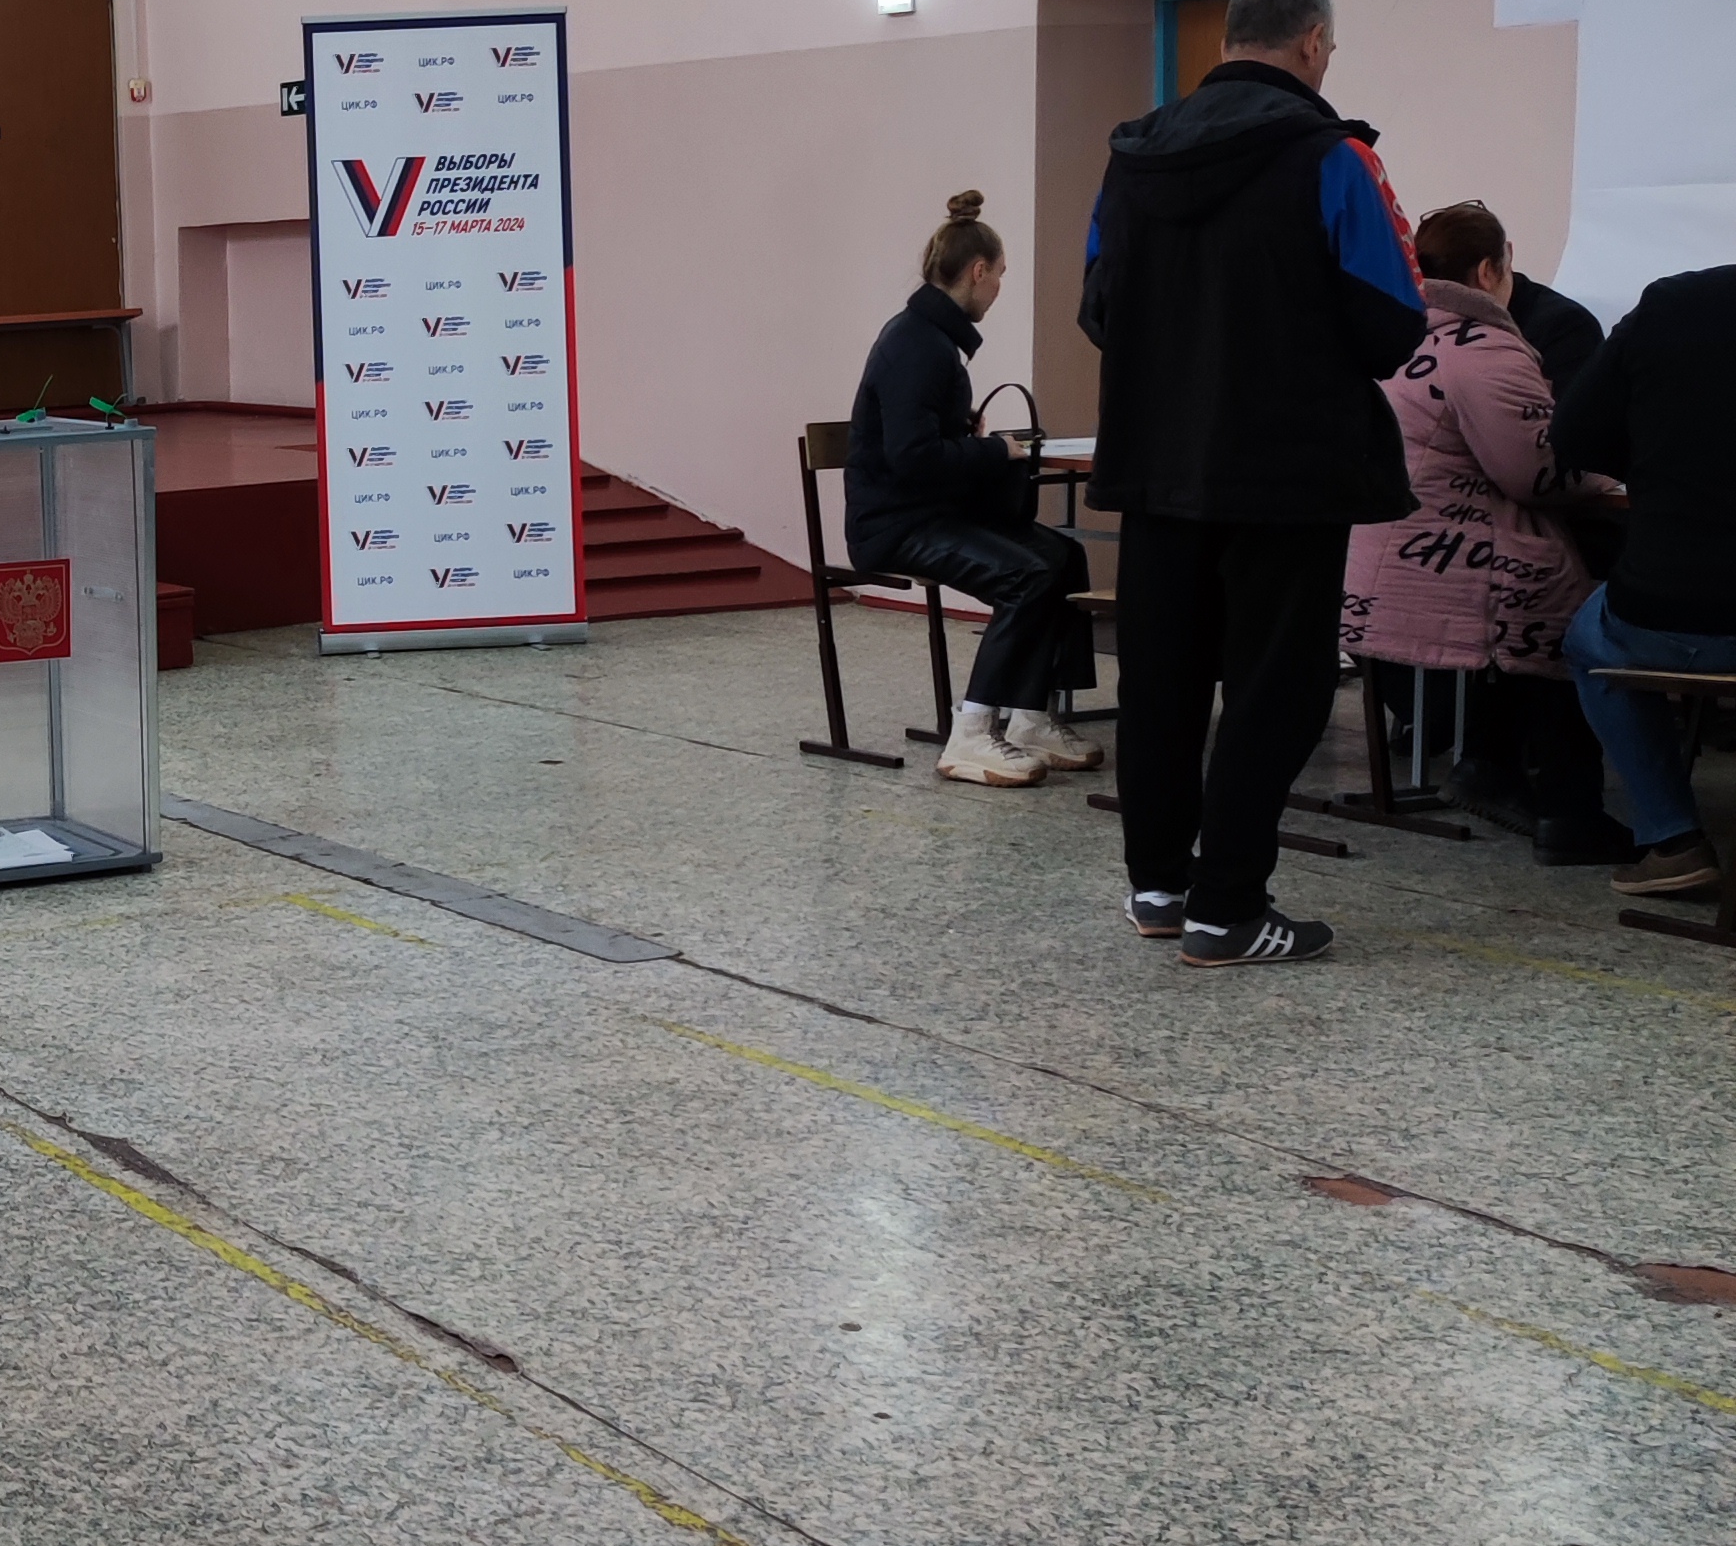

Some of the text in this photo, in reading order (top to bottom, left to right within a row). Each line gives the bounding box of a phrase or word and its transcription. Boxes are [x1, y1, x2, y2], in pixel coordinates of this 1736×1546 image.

[418, 57, 455, 68] ЦИК.РФ
[497, 93, 534, 104] ЦИК.РФ
[341, 100, 378, 111] ЦИК.РФ
[434, 153, 516, 172] ВЫБОРЫ
[426, 173, 540, 194] ПРЕЗИДЕНТА
[417, 197, 491, 216] РОССИИ
[447, 218, 492, 234] МАРТА
[494, 217, 525, 232] 2024
[425, 280, 462, 291] ЦИК.РФ
[504, 318, 541, 329] ЦИК.РФ
[348, 325, 385, 336] ЦИК.РФ
[428, 364, 464, 375] ЦИК.РФ
[507, 401, 544, 412] ЦИК.РФ
[351, 409, 388, 420] ЦИК.РФ
[430, 448, 467, 459] ЦИК.РФ
[510, 486, 547, 497] ЦИК.РФ
[354, 493, 391, 504] ЦИК.РФ
[433, 532, 470, 543] ЦИК.РФ
[513, 568, 550, 579] ЦИК.РФ
[357, 575, 394, 586] ЦИК.РФ
